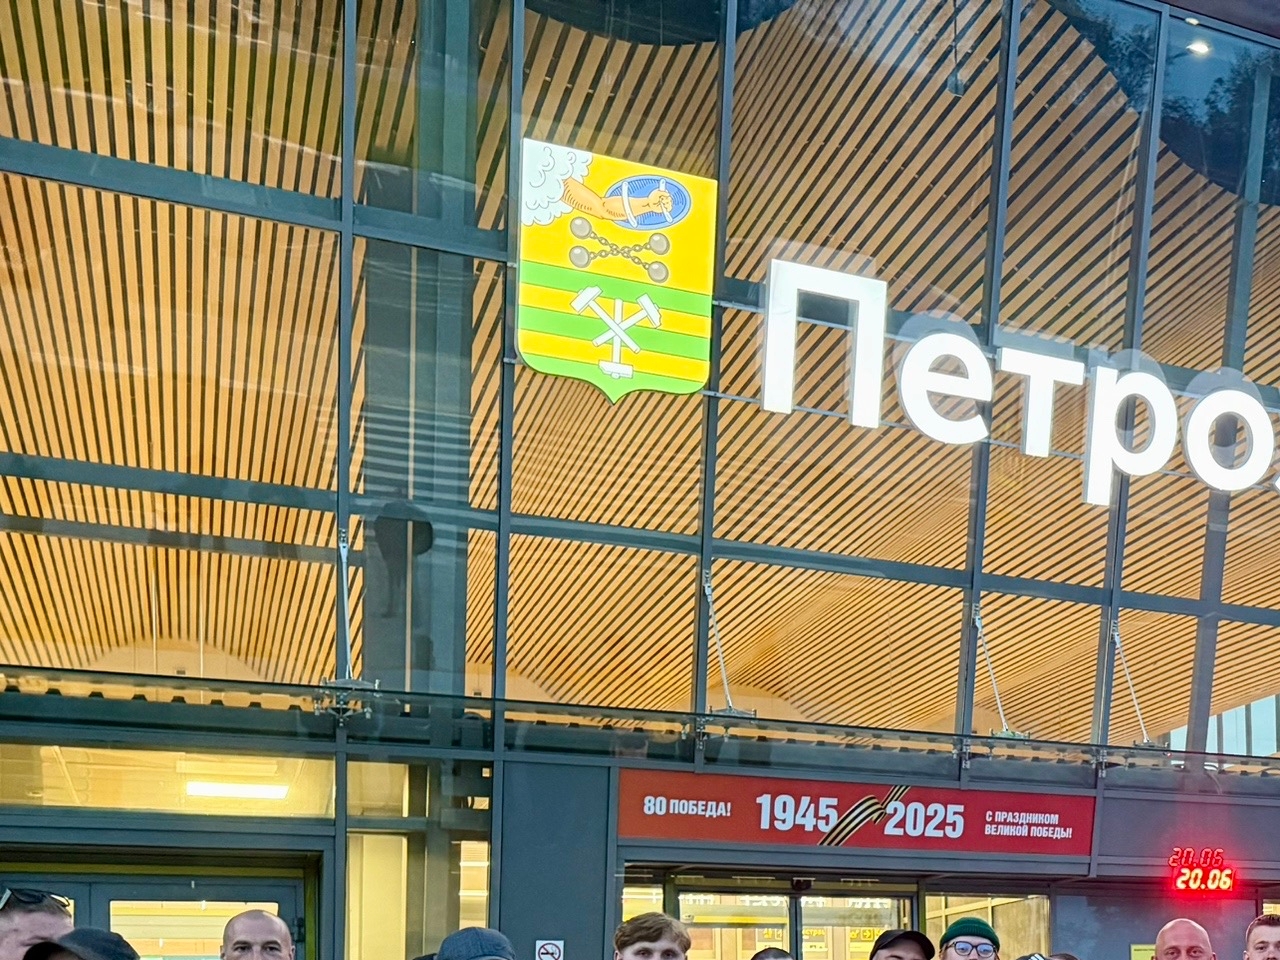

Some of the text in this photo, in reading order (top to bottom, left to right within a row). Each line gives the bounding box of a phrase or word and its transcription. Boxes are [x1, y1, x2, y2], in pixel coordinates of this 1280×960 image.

[643, 796, 732, 818] 80 ПОБЕДА!
[756, 794, 965, 838] 1945 2025
[985, 810, 1059, 825] С ПРАЗДНИКОМ
[984, 824, 1073, 839] ВЕЛИКОЙ ПОБЕДЫ!
[1175, 867, 1233, 890] 20.06
